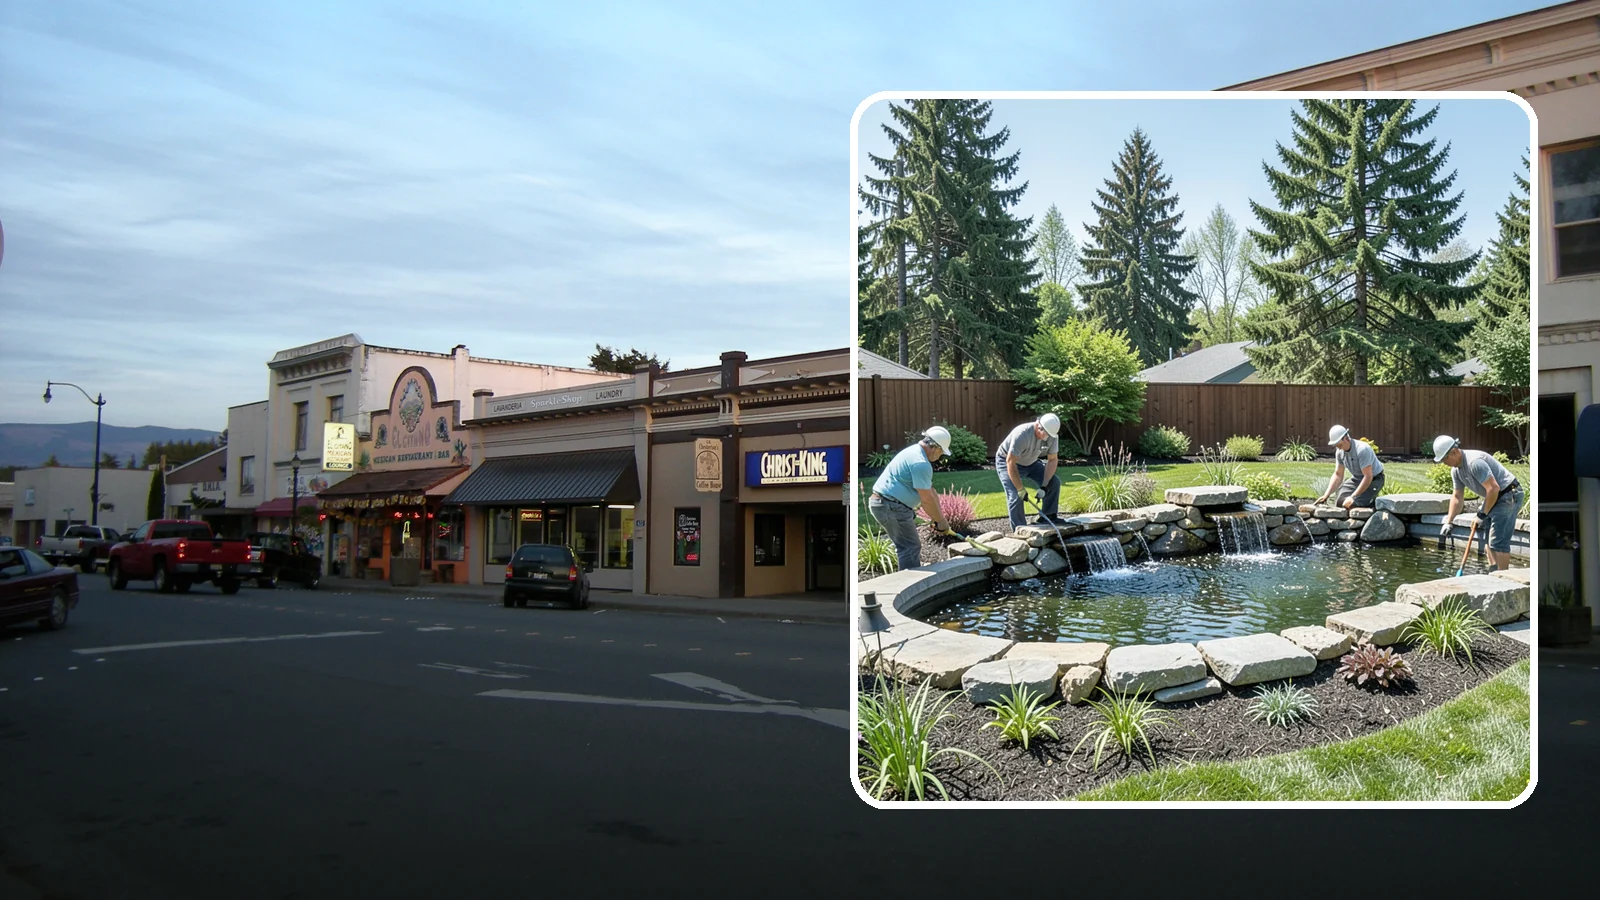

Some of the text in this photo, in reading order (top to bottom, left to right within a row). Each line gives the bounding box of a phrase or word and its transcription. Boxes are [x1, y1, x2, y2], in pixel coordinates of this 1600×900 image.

[595, 389, 623, 400] LAUNDRY
[493, 402, 522, 412] LAVANDERIA
[373, 455, 396, 464] MEXICAN
[397, 451, 433, 462] RESTAURANT
[437, 450, 450, 459] BAR
[761, 450, 828, 478] CHRIST KING
